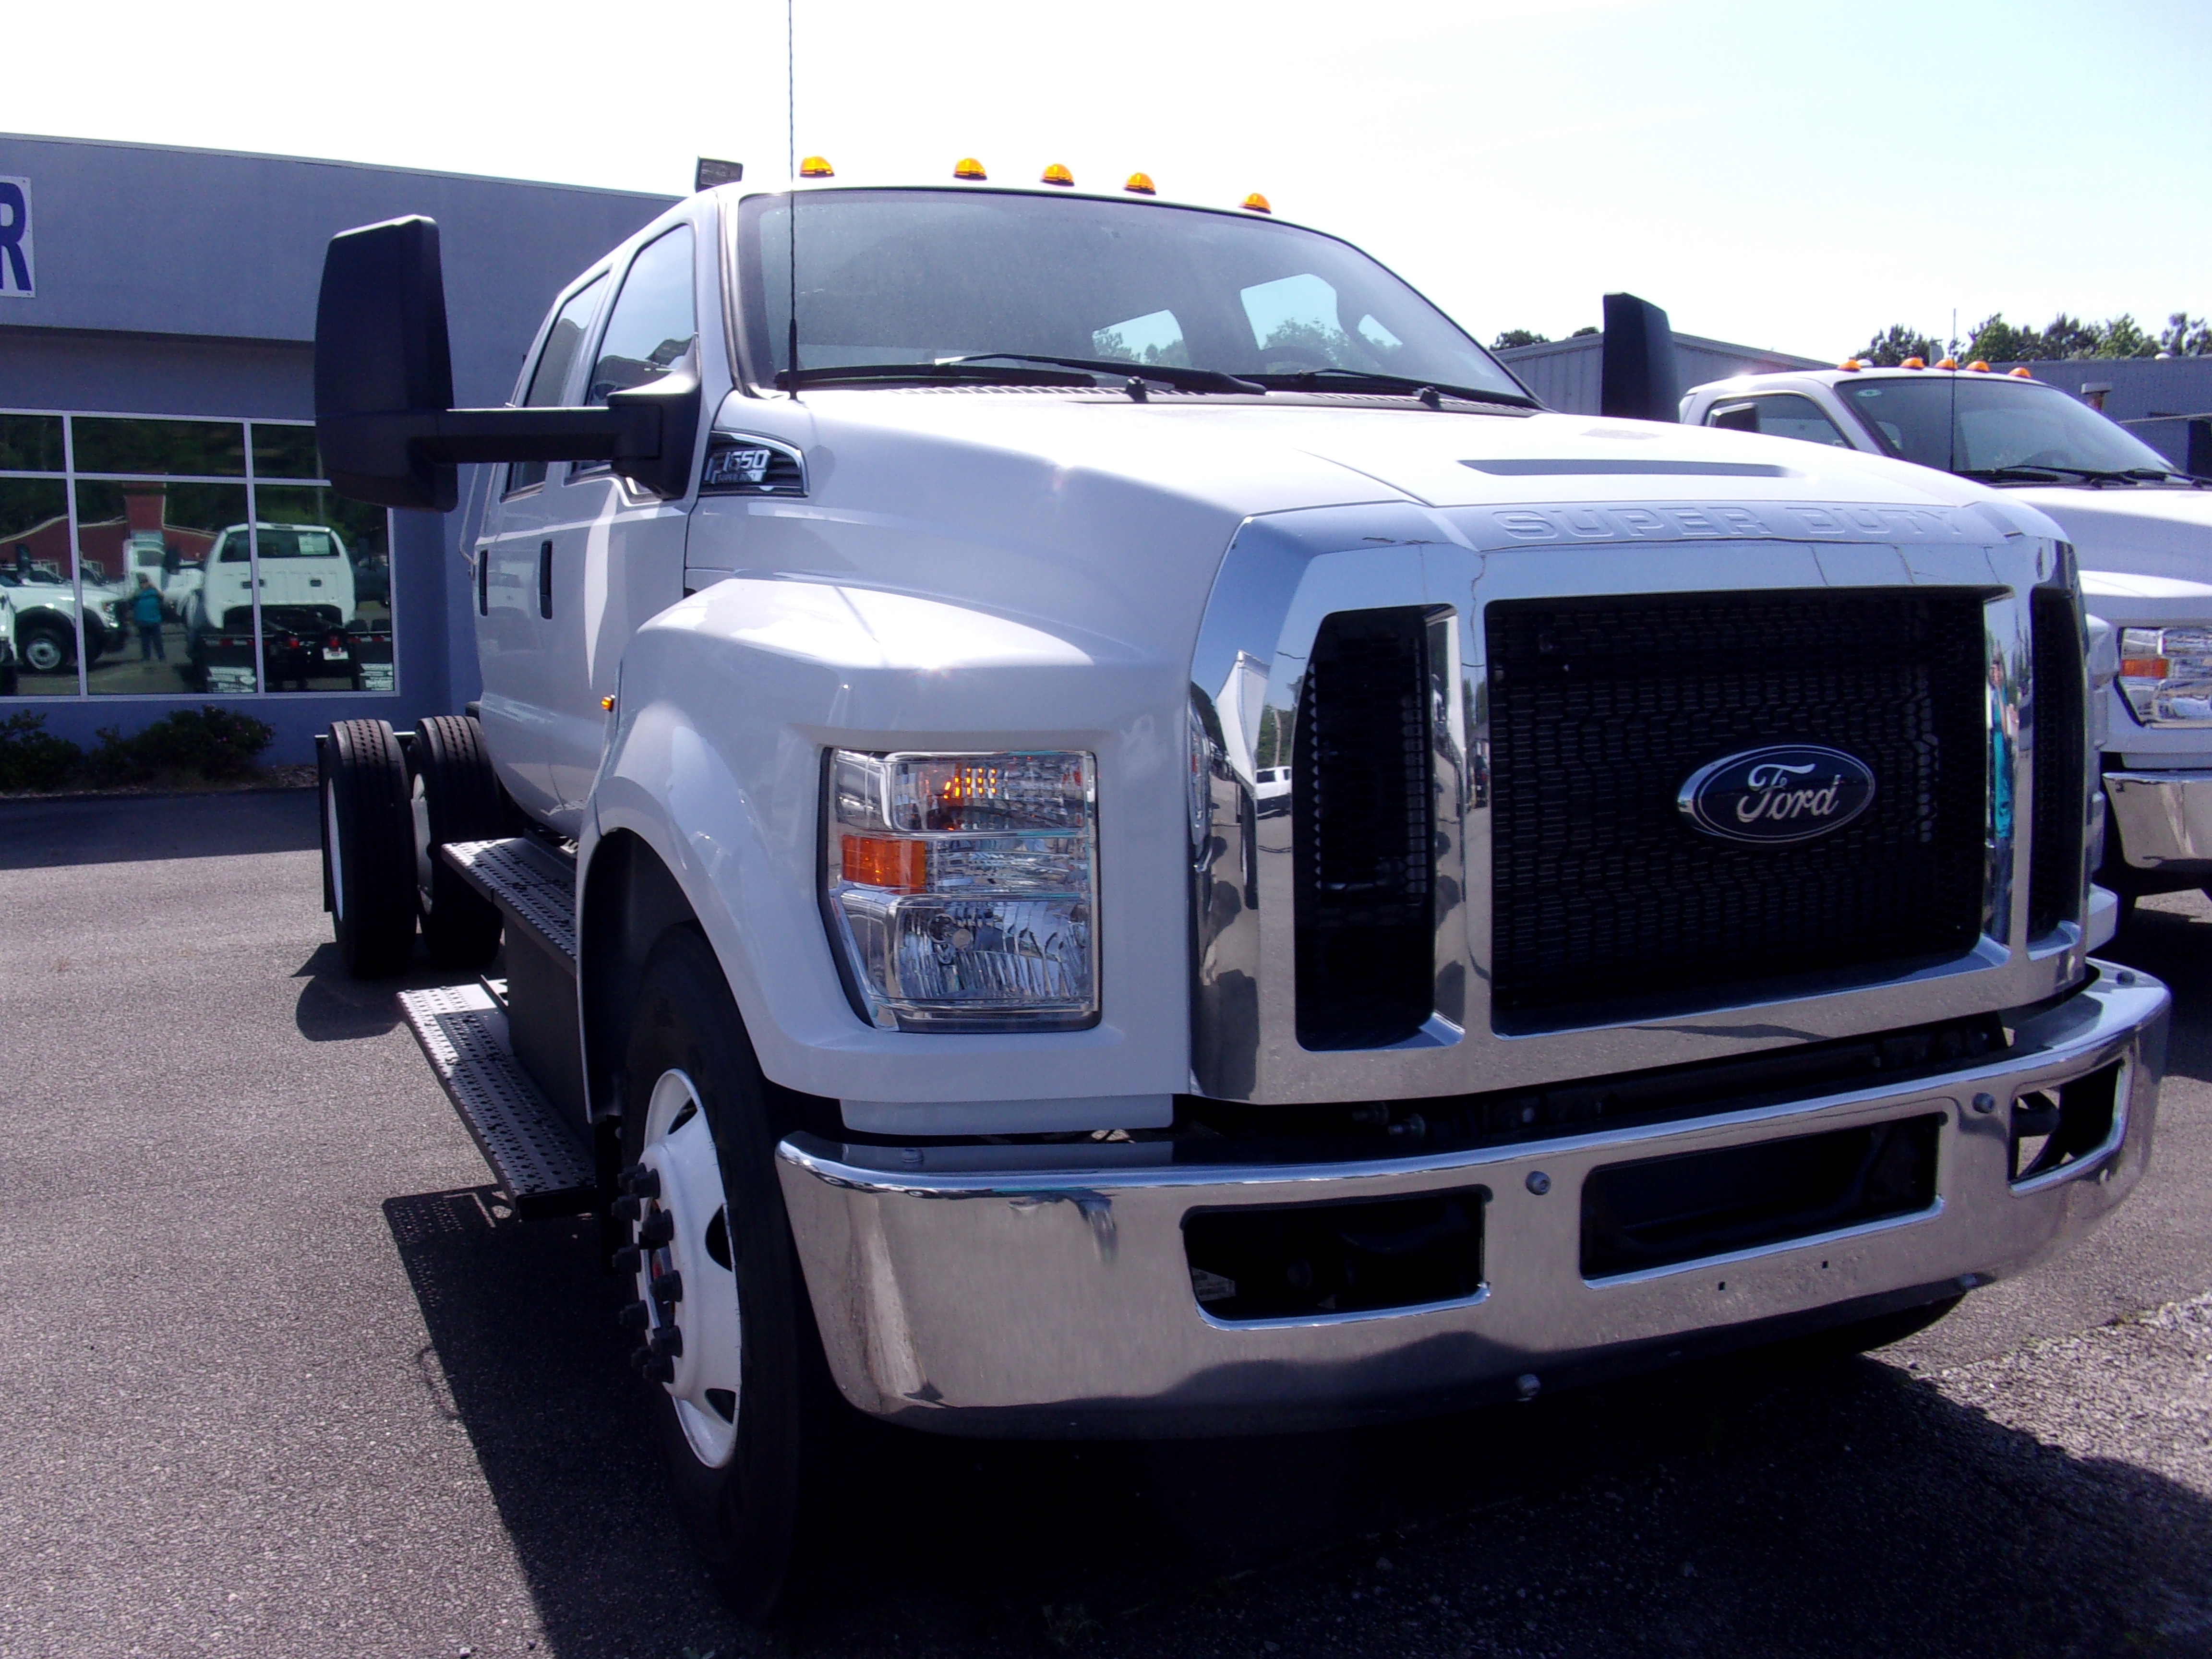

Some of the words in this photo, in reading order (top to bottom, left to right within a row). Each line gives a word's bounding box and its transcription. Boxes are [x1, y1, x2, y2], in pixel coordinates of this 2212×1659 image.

[0, 182, 32, 291] R
[1492, 507, 1772, 540] SUPER
[1785, 506, 1963, 535] DUTY
[1736, 763, 1841, 823] Ford
